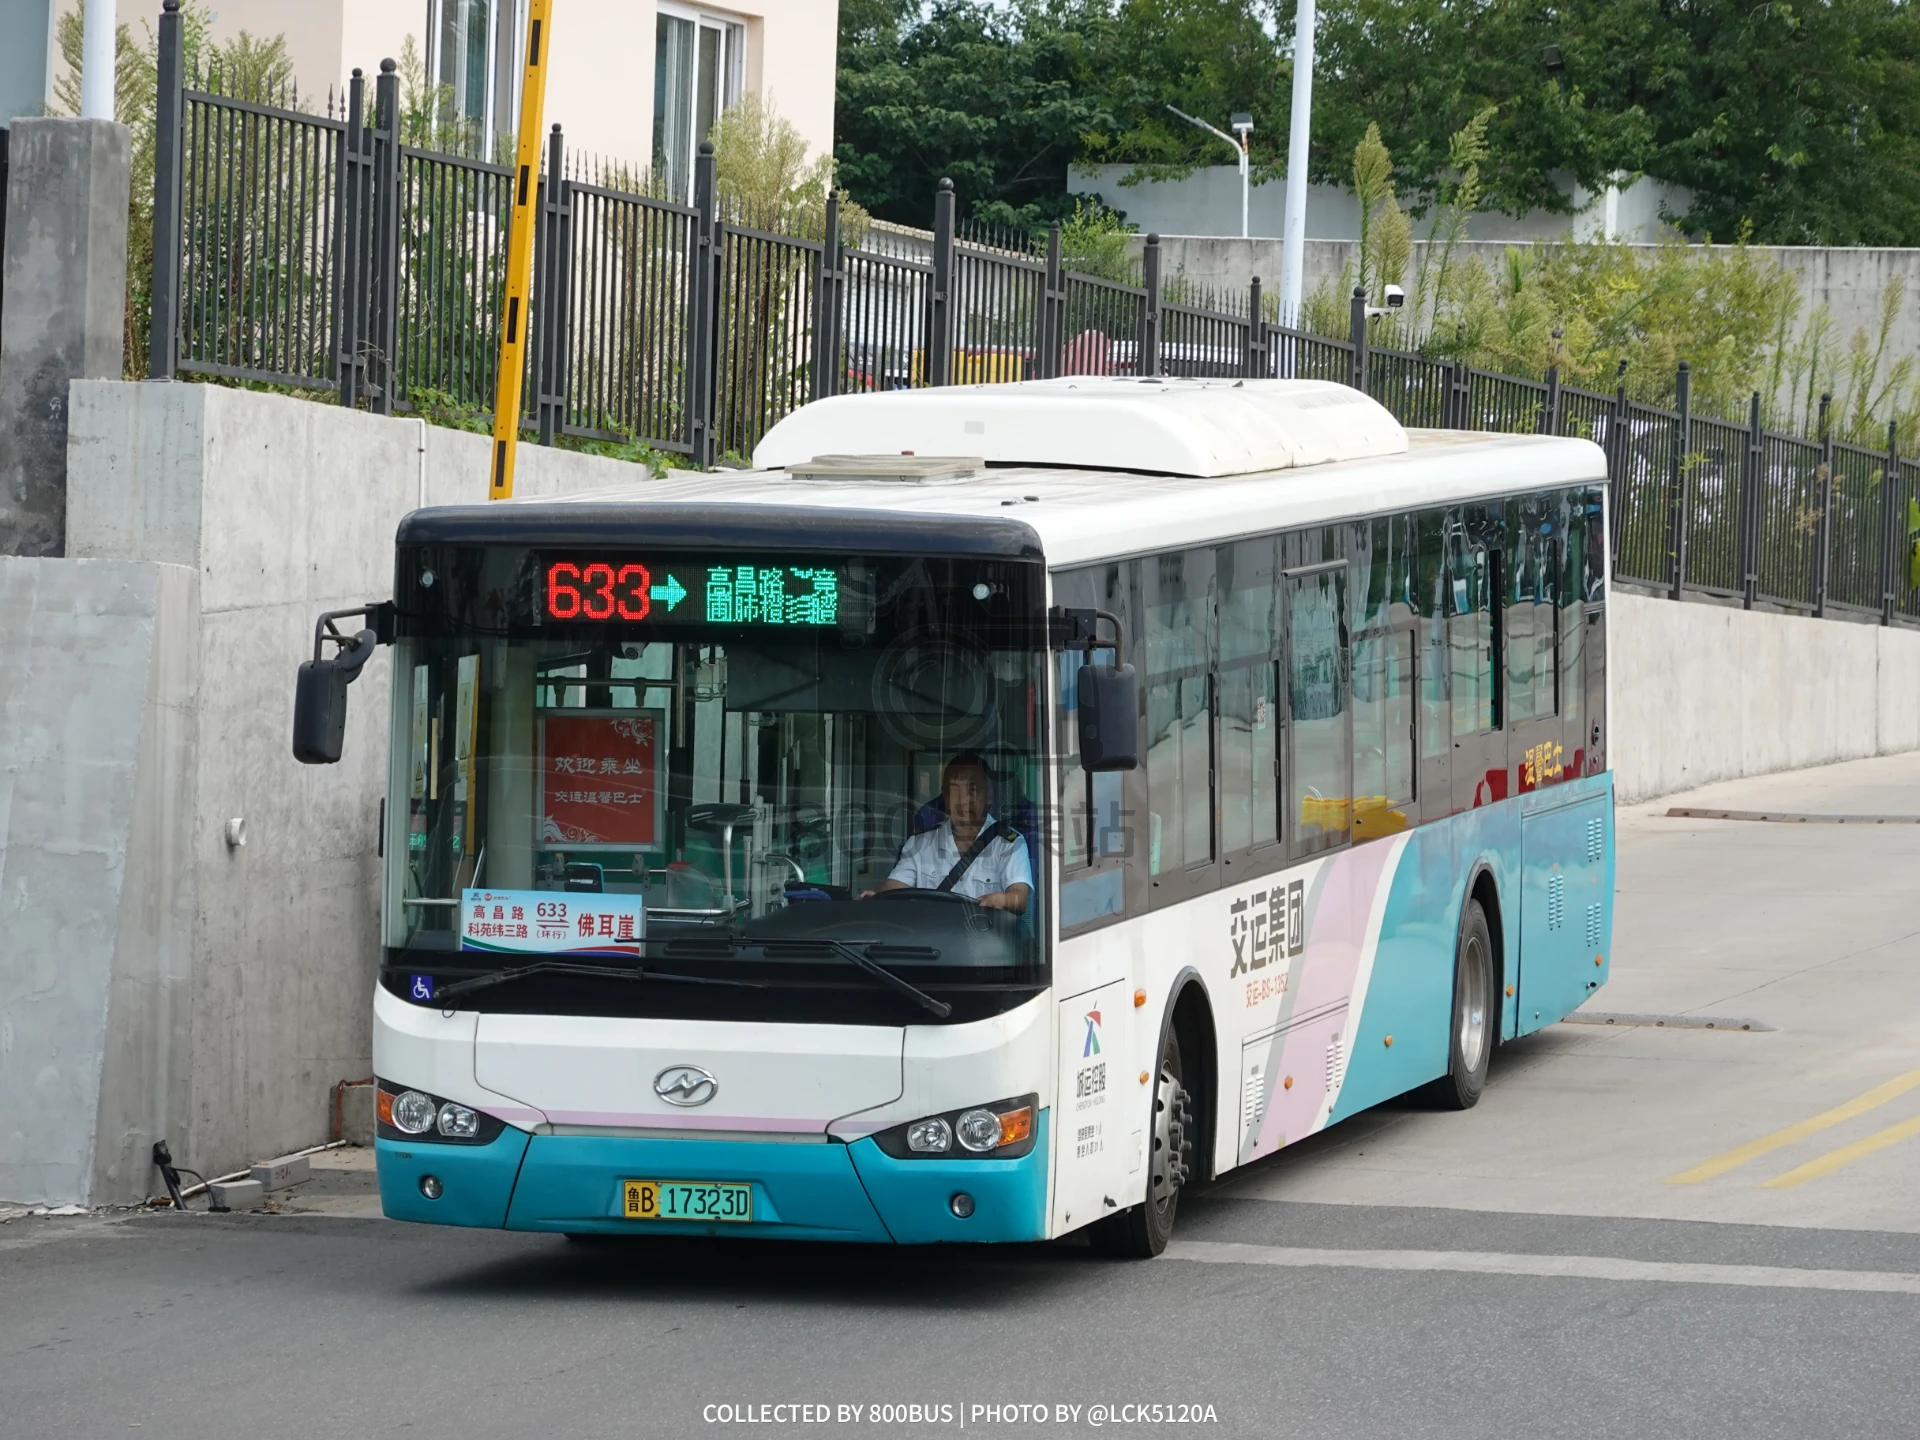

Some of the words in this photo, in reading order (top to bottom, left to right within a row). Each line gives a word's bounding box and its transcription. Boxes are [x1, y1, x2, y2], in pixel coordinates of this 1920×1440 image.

[548, 562, 651, 620] 633
[554, 756, 643, 775] 欢迎乘坐
[554, 791, 643, 804] 交运温馨巴士
[473, 905, 524, 921] 高昌路
[537, 902, 568, 918] 633
[468, 922, 528, 939] 科苑纬三路
[577, 912, 635, 940] 佛耳崖
[1230, 878, 1304, 979] 交运集团
[1076, 1062, 1106, 1099] 城运控股
[627, 1186, 655, 1213] 鲁B
[668, 1187, 748, 1216] 17323D
